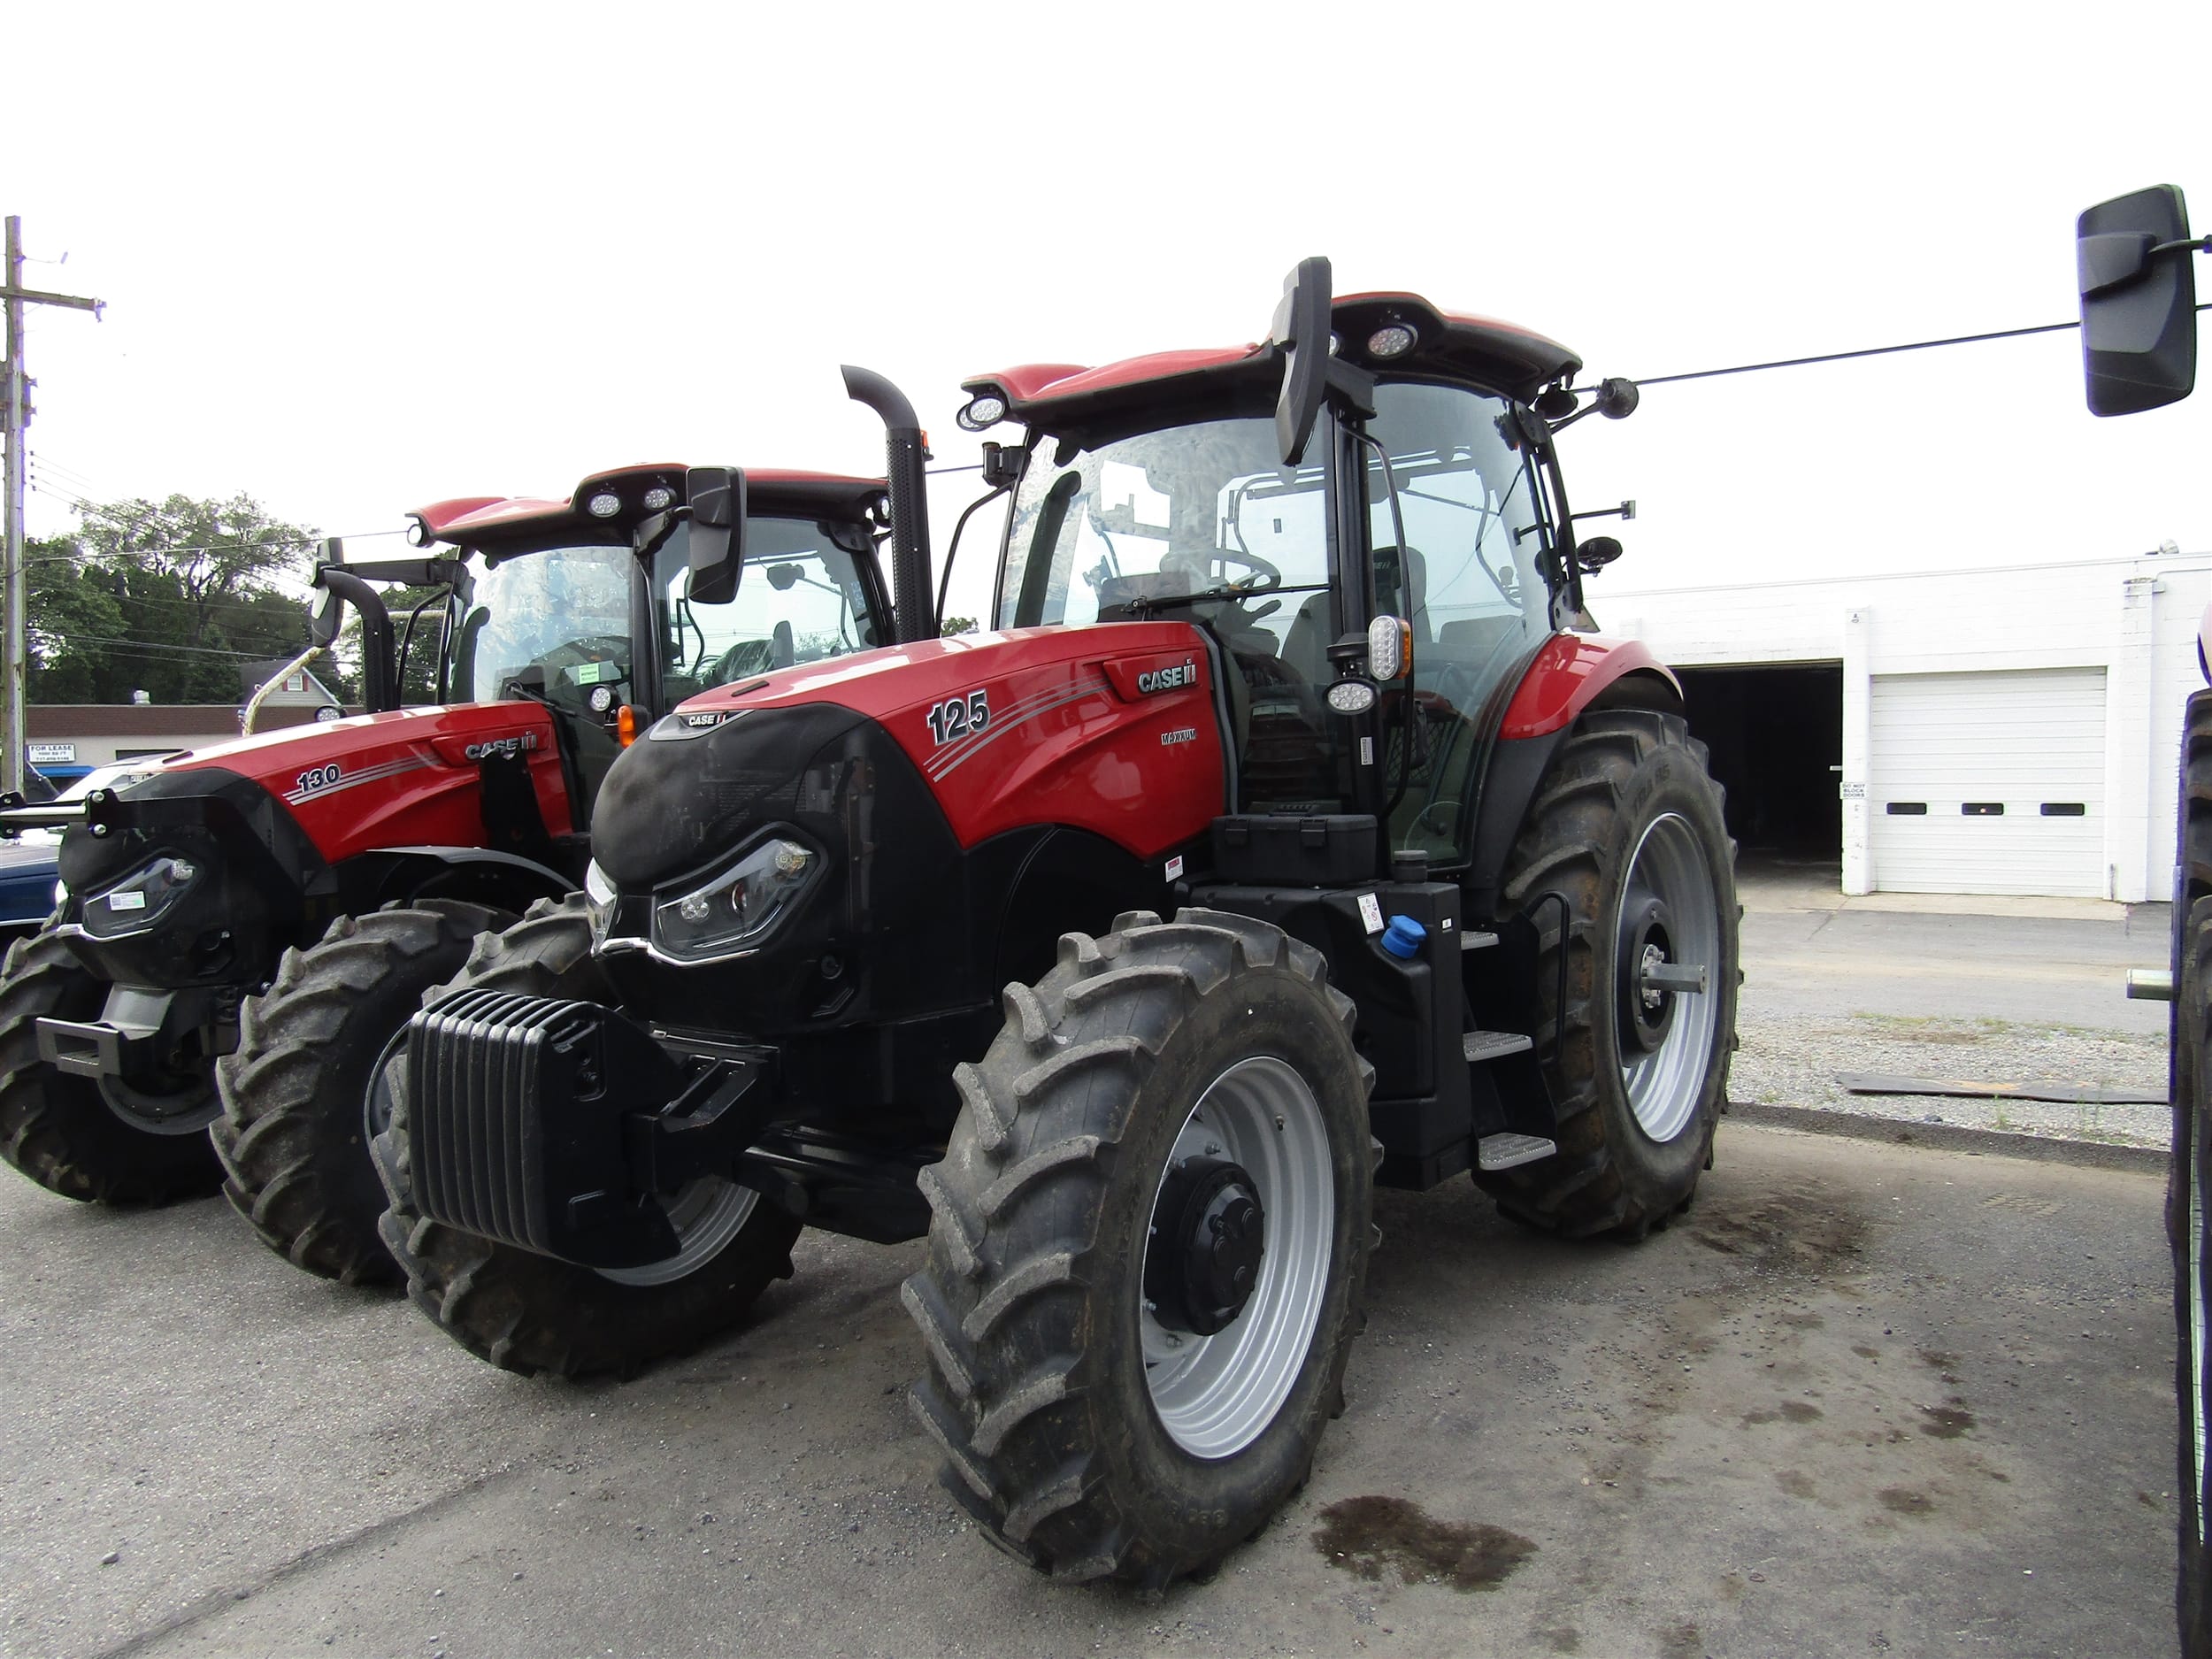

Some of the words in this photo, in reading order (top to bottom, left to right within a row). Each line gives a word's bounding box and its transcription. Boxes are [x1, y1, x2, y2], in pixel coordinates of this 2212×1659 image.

[1138, 666, 1182, 693] CASE
[689, 714, 715, 726] CASE
[926, 688, 990, 746] 125
[465, 737, 518, 759] CASE
[1161, 728, 1195, 746] MAXXUM
[296, 764, 341, 793] 130
